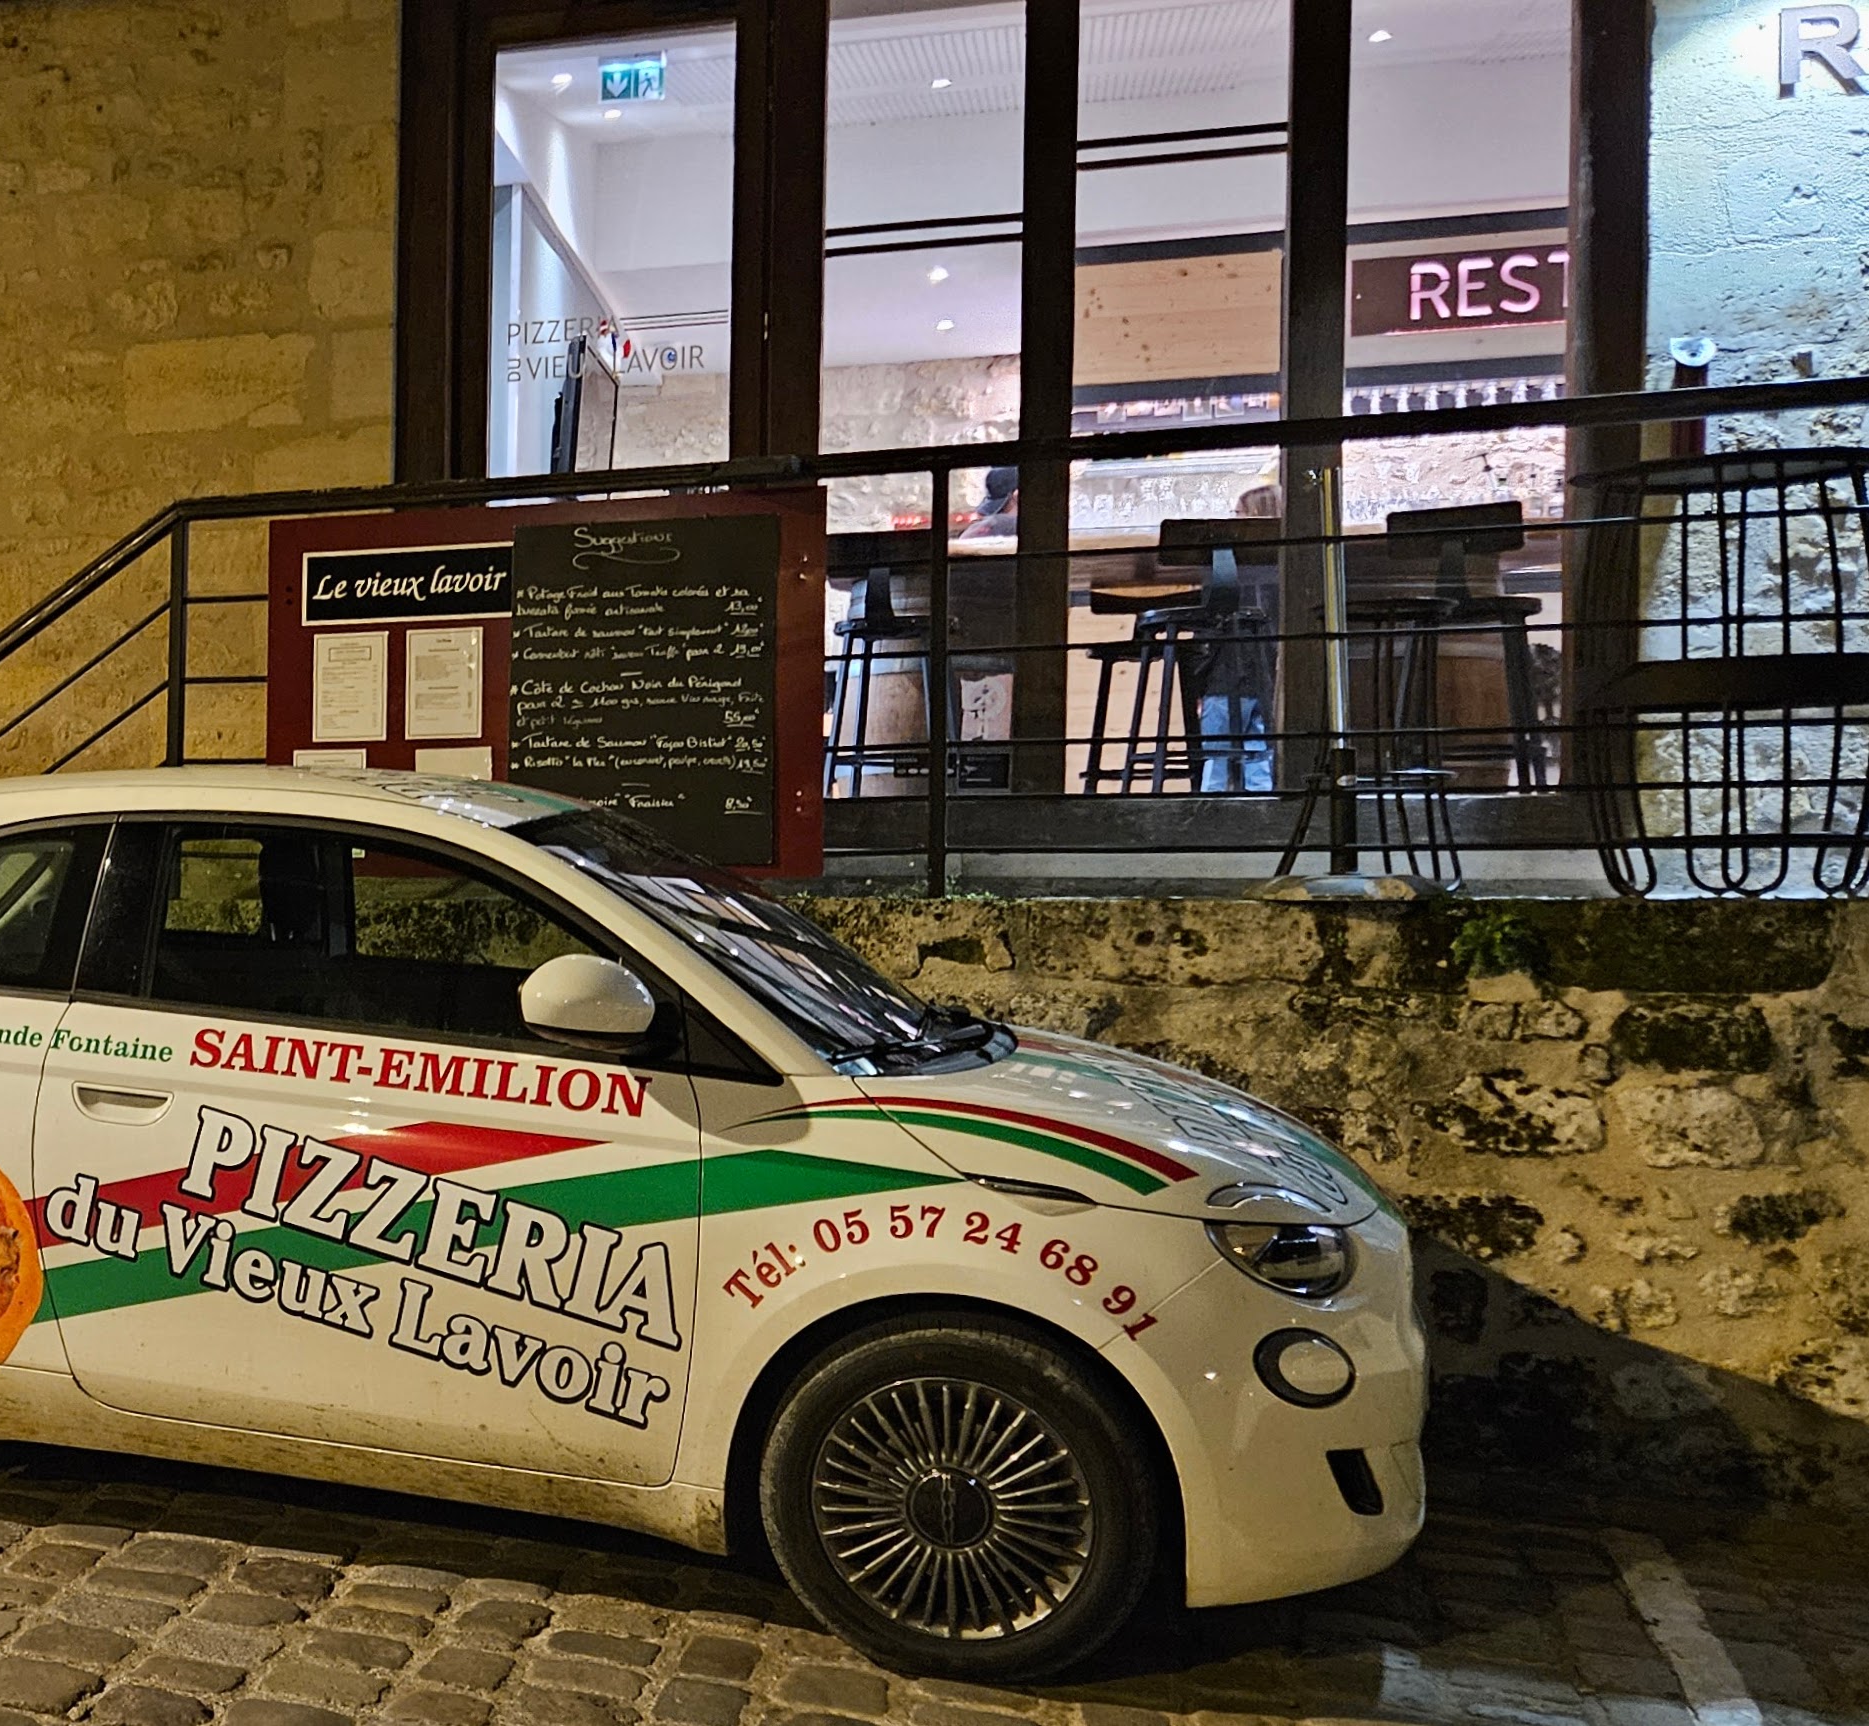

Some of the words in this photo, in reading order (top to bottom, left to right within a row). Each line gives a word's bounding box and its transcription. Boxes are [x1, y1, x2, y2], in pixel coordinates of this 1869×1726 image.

[1778, 4, 1869, 85] R
[507, 315, 619, 346] PIZZERIA
[526, 353, 588, 380] VIEU
[573, 527, 673, 554] Suggestions
[312, 574, 347, 600] Le
[354, 571, 427, 602] vieux
[429, 564, 508, 594] lavoir
[527, 586, 567, 603] Potage
[569, 584, 598, 599] Froid
[715, 586, 731, 598] et
[523, 621, 569, 639] Tartare
[574, 626, 588, 639] de
[712, 644, 727, 655] 2
[521, 678, 554, 695] Côte
[559, 680, 575, 694] de
[579, 679, 625, 695] Cochon
[631, 678, 663, 691] Noir
[667, 676, 685, 689] du
[550, 695, 566, 710] 2
[521, 731, 571, 749] Tartare
[575, 736, 593, 749] de
[597, 736, 648, 750] Saumon
[49, 1027, 175, 1064] Fontaine
[189, 1027, 652, 1118] SAINT-EMILION
[178, 1104, 683, 1353] PIZZERIA
[721, 1239, 805, 1312] Tél:
[813, 1207, 872, 1255] 05
[889, 1202, 947, 1239] 57
[962, 1210, 1023, 1256] 24
[1039, 1237, 1100, 1289] 68
[1101, 1283, 1161, 1343] 91
[43, 1173, 143, 1261] du
[157, 1197, 382, 1340] Vieux
[388, 1275, 671, 1430] Lavoir
